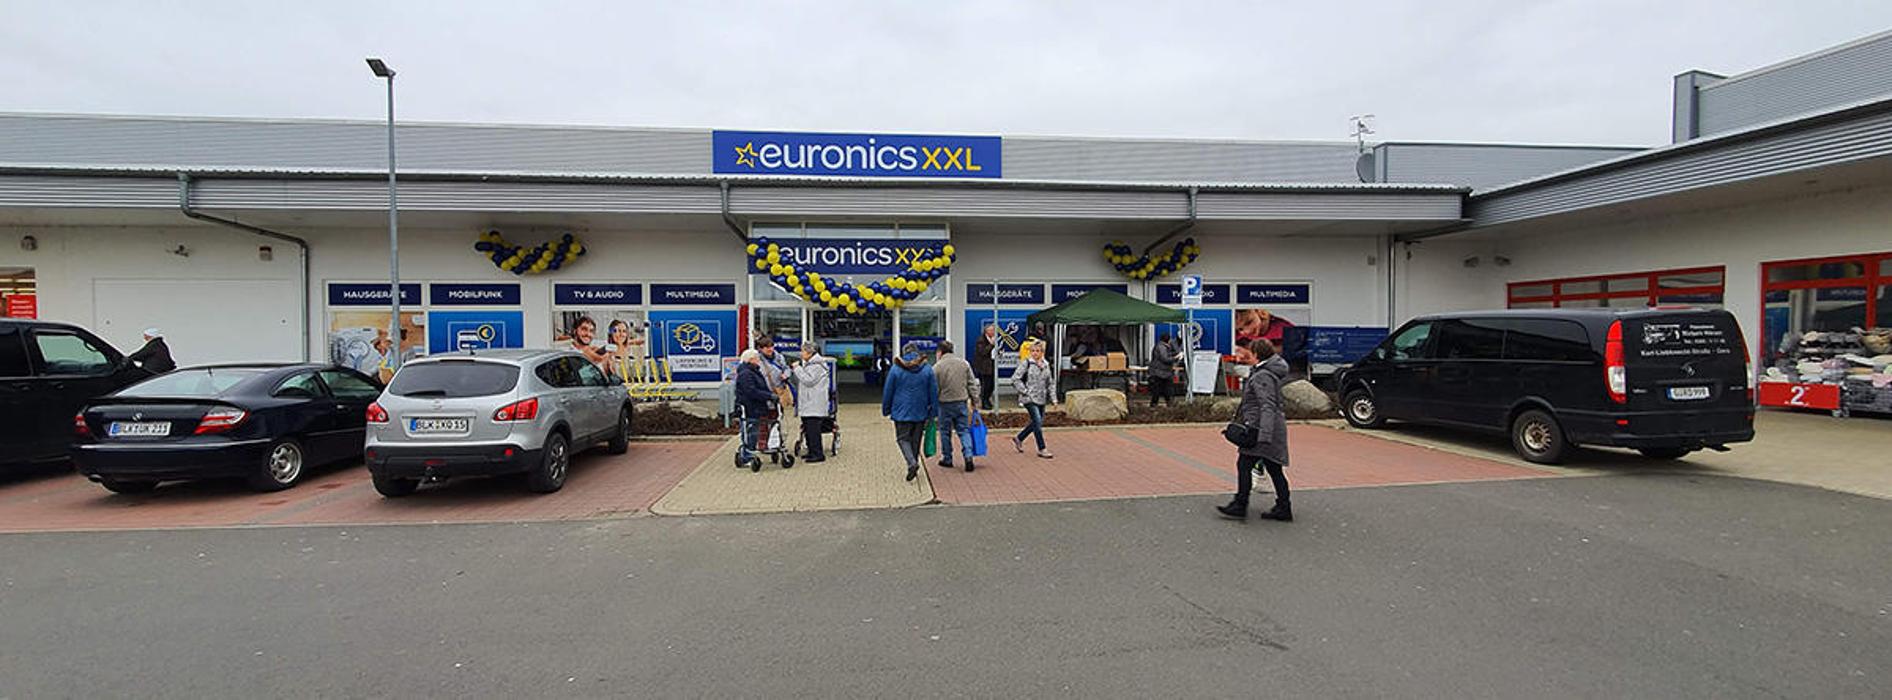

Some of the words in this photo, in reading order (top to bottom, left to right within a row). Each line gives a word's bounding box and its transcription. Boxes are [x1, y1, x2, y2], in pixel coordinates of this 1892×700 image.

[759, 138, 917, 169] euronics
[922, 146, 982, 171] XXL
[1183, 277, 1197, 295] P
[448, 289, 503, 299] MOBILFUNK
[573, 290, 585, 299] TV
[595, 290, 624, 299] AUDIO
[665, 290, 720, 299] MULTIMEDIA
[1249, 290, 1296, 298] MULTIMEDIA
